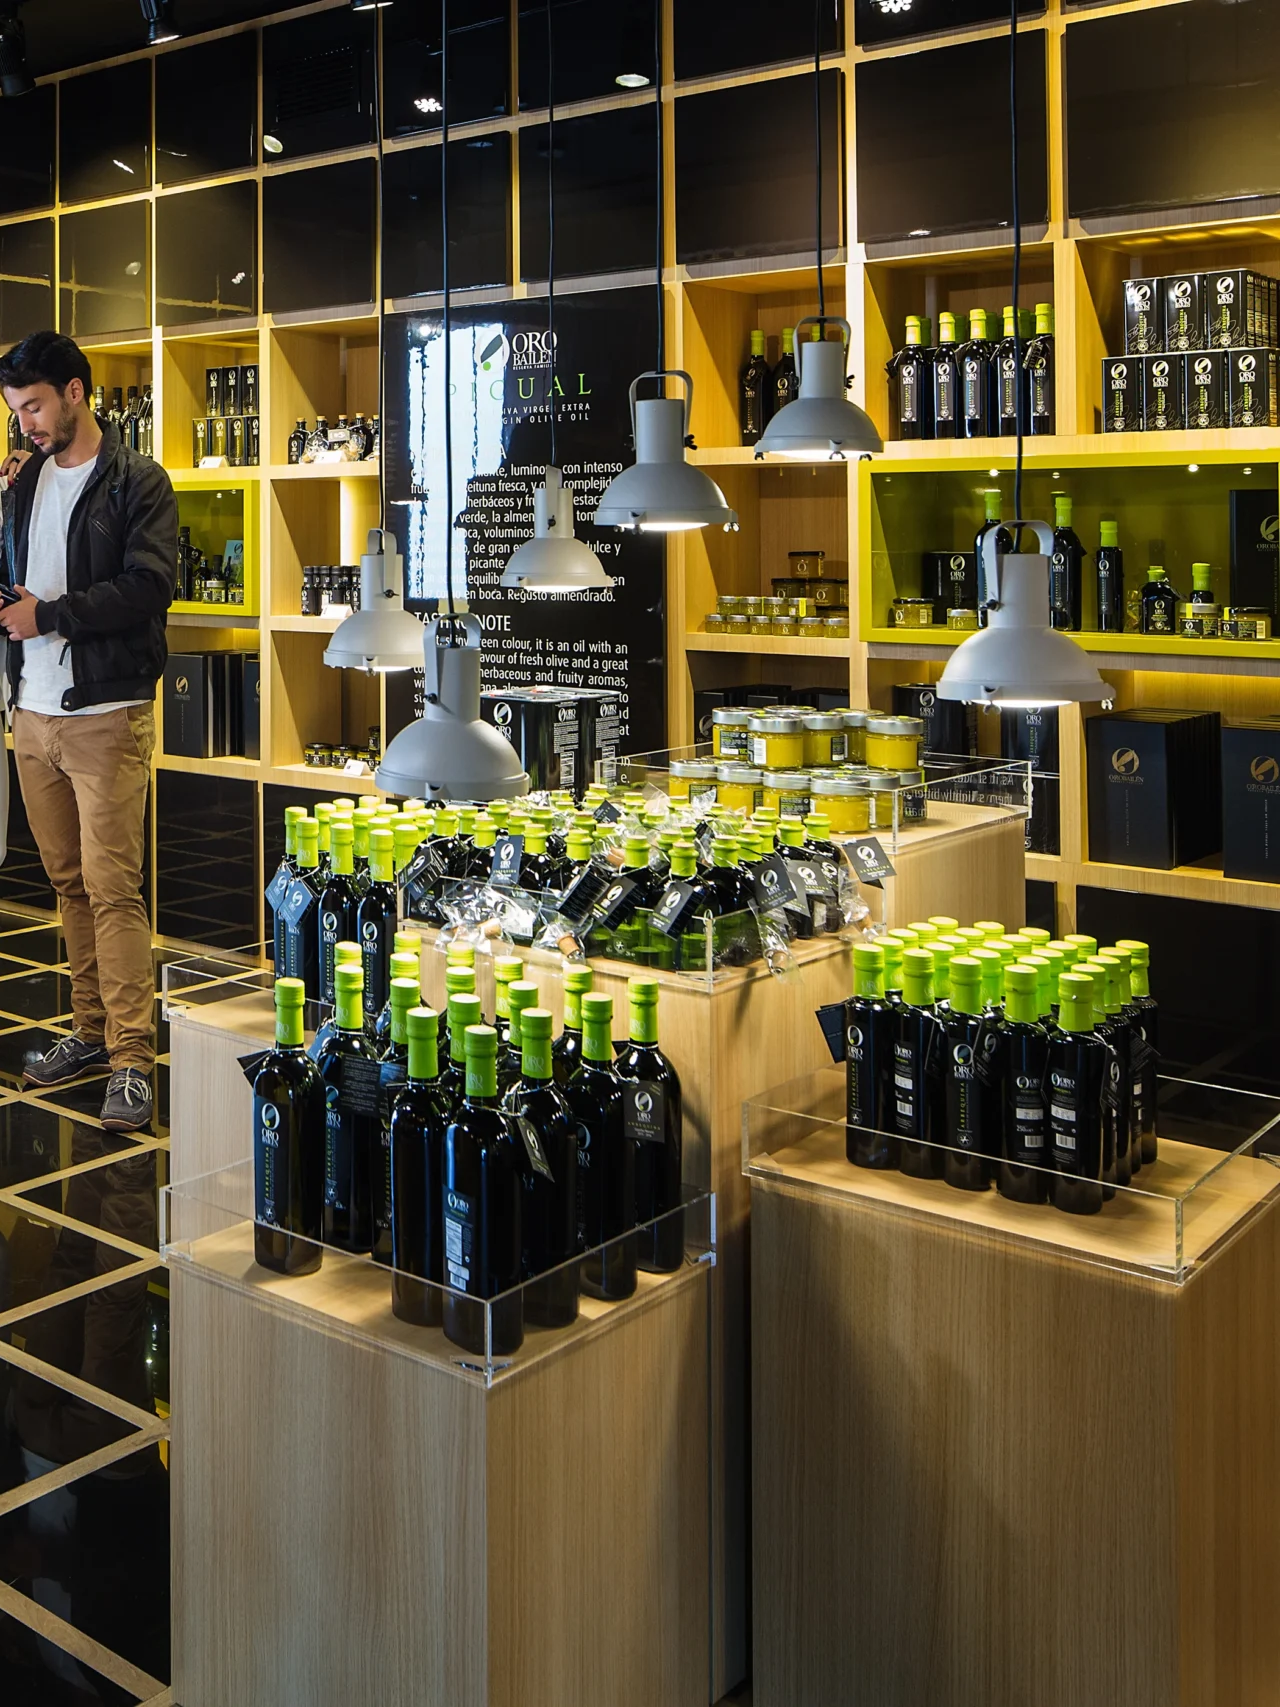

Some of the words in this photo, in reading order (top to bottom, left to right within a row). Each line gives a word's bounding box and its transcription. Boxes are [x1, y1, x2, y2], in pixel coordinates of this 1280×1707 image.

[512, 330, 558, 354] ORO
[562, 403, 590, 412] EXTRA
[570, 413, 589, 421] OIL
[562, 463, 580, 475] con
[583, 461, 623, 473] intenso
[498, 480, 528, 493] fresca,
[467, 495, 514, 507] herbáceos
[516, 497, 523, 509] y
[459, 510, 489, 524] verde,
[492, 510, 500, 523] la
[488, 545, 510, 556] gran
[469, 559, 506, 570] picante.
[479, 588, 504, 600] boca.
[477, 615, 511, 631] NOTE
[501, 637, 533, 652] colour,
[535, 639, 543, 651] it
[546, 641, 554, 651] is
[557, 641, 570, 652] an
[572, 640, 585, 653] oil
[588, 641, 612, 653] with
[615, 644, 628, 655] an
[519, 653, 543, 666] fresh
[545, 655, 570, 668] olive
[571, 657, 590, 669] and
[592, 659, 599, 669] a
[601, 659, 629, 673] great
[535, 670, 554, 683] and
[557, 670, 584, 687] fruity
[587, 675, 629, 689] aromas,
